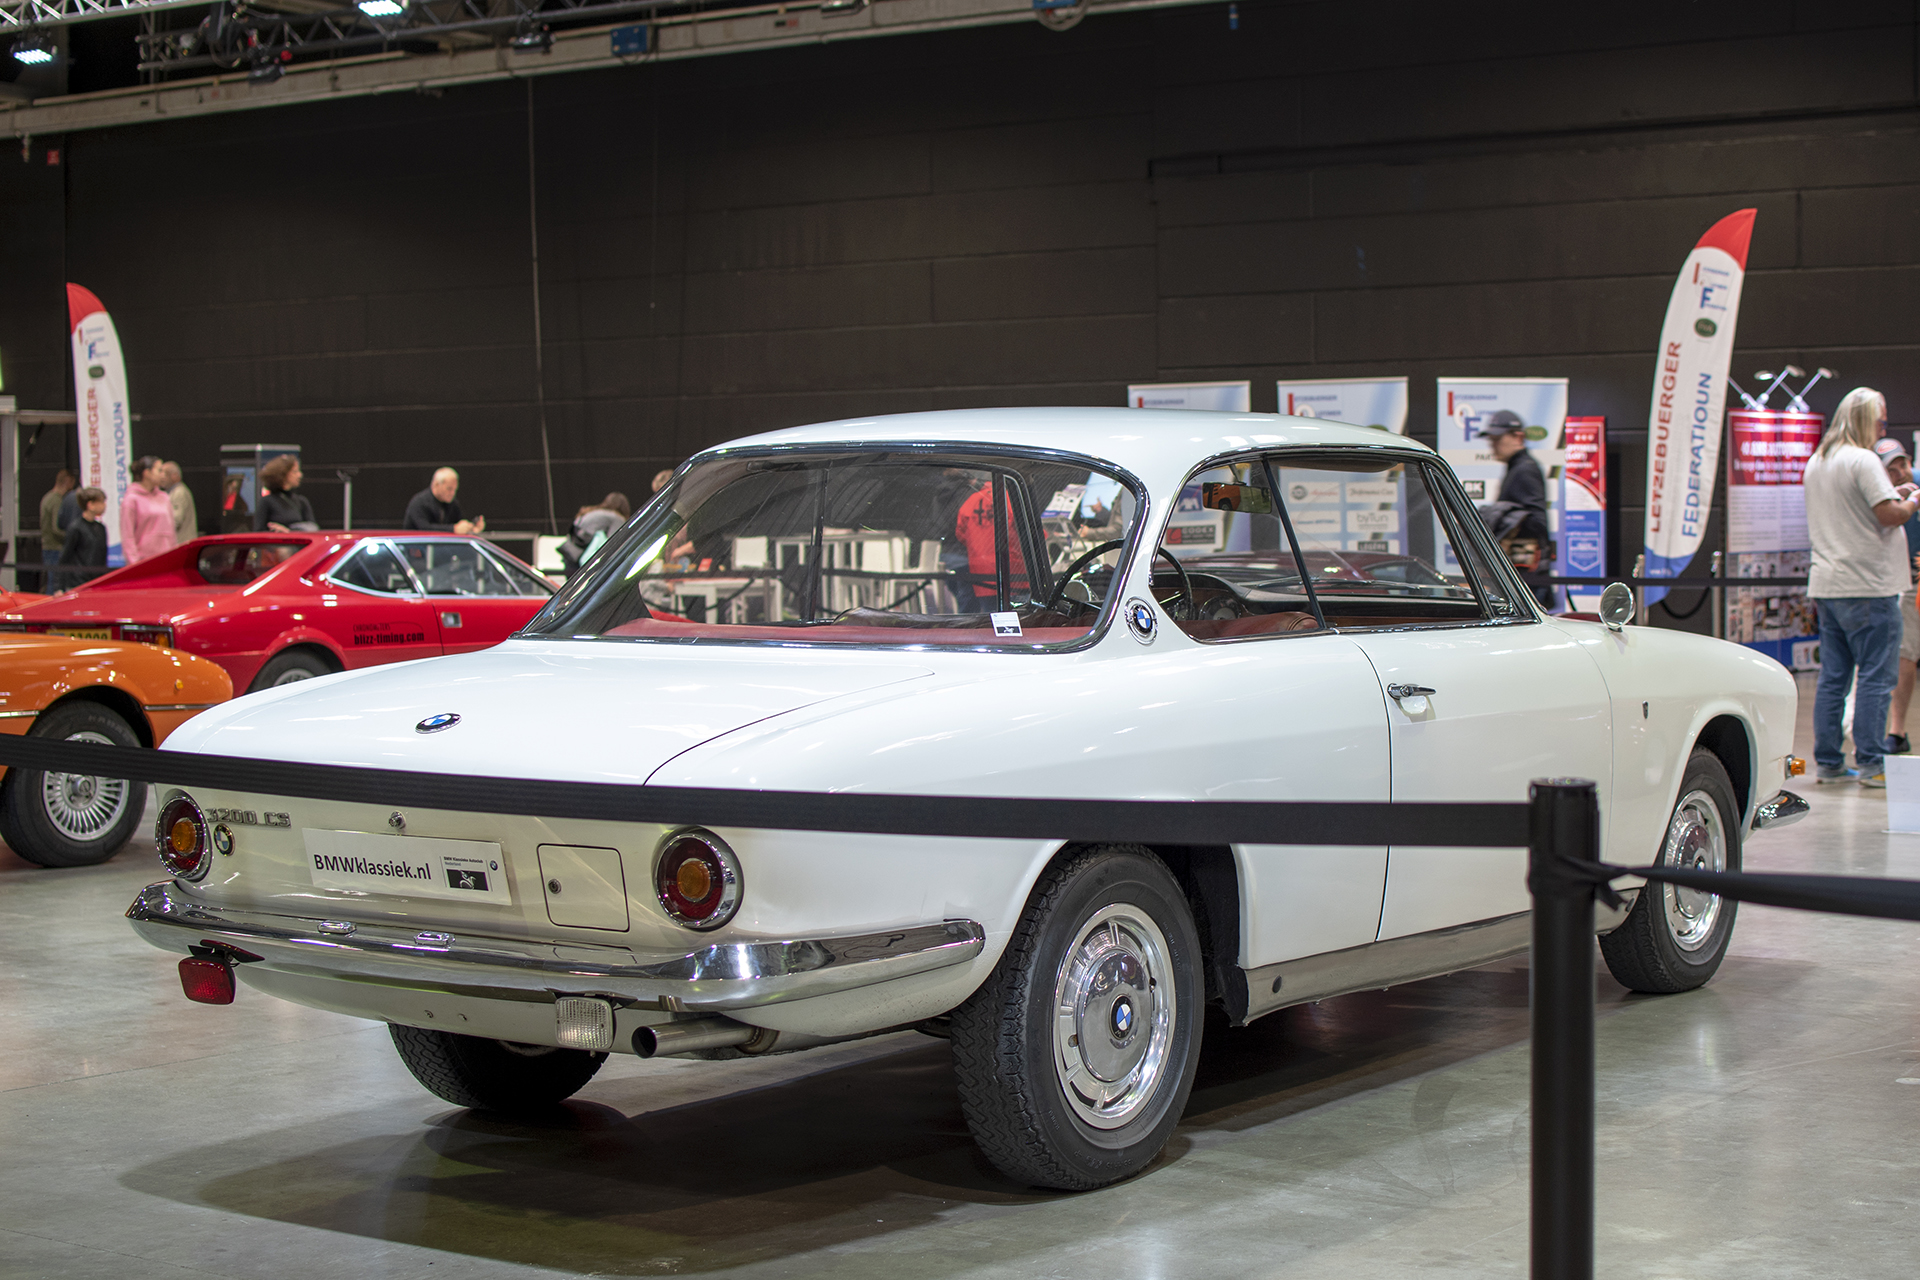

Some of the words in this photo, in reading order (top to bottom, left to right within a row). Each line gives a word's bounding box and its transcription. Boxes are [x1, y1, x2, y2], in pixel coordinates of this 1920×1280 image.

[1650, 341, 1682, 534] LETZEBUERGER
[1681, 372, 1713, 538] FEDERATIOUN
[354, 632, 425, 645] blizz-timing.com
[204, 808, 258, 825] 3200
[264, 811, 291, 829] CS
[313, 854, 432, 880] BMWklassiek.nl
